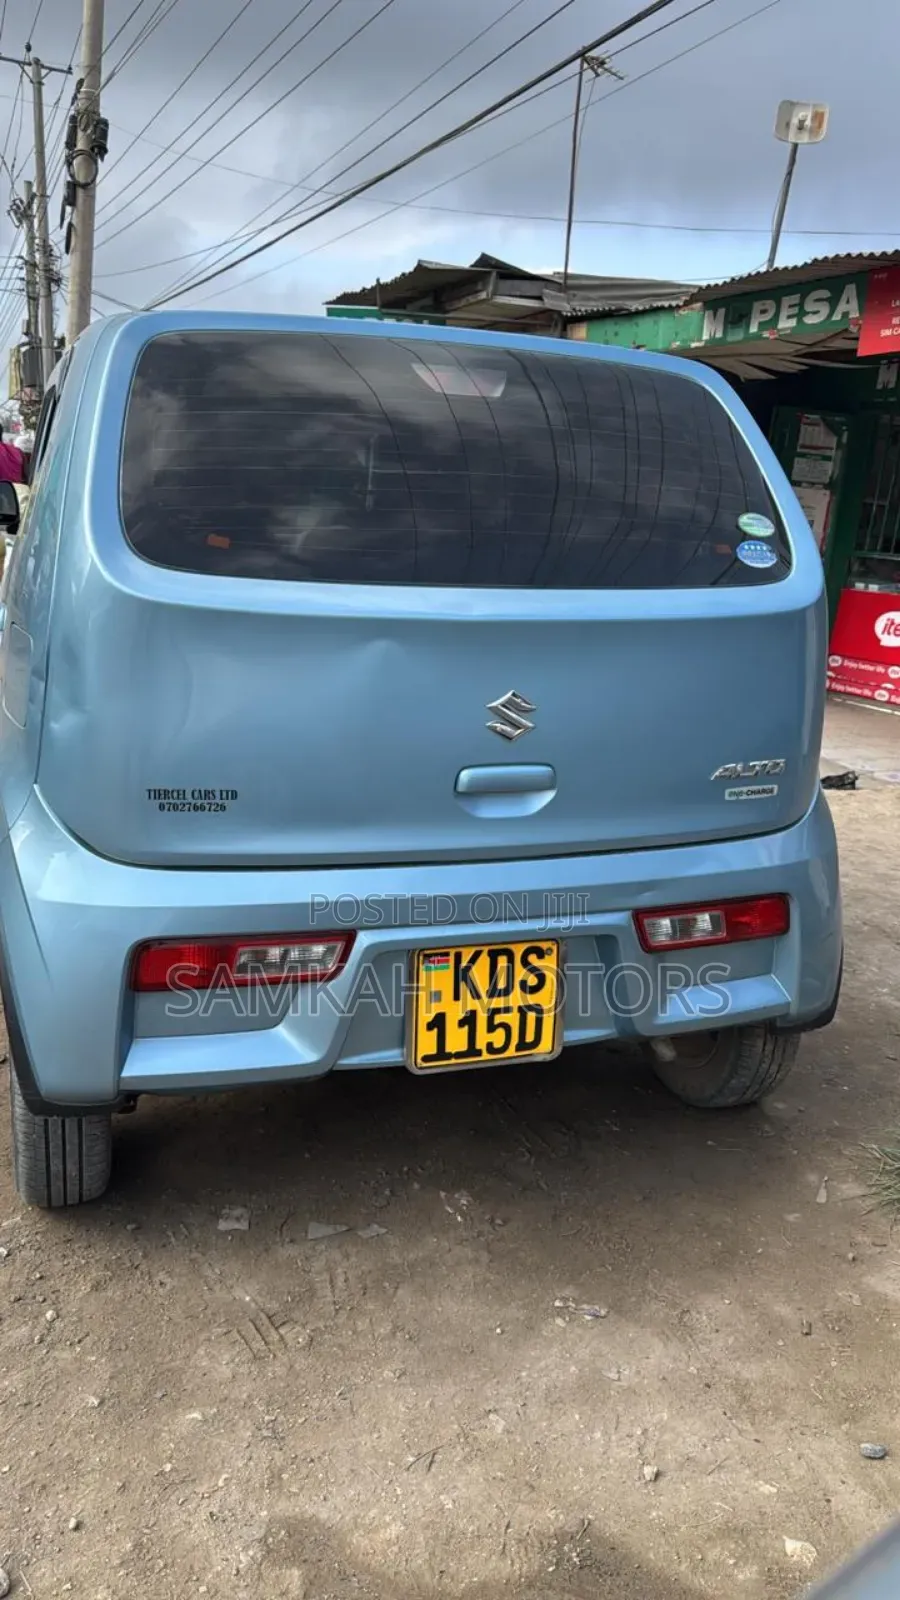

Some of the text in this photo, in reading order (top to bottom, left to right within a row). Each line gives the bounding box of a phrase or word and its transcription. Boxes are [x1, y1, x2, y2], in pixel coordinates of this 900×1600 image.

[749, 283, 860, 334] PESA
[710, 759, 786, 781] ALTO
[146, 788, 238, 801] TIERCEL CARS LTD
[158, 802, 227, 812] 0702766726
[453, 946, 547, 1002] KDS
[421, 1003, 544, 1063] 115D
